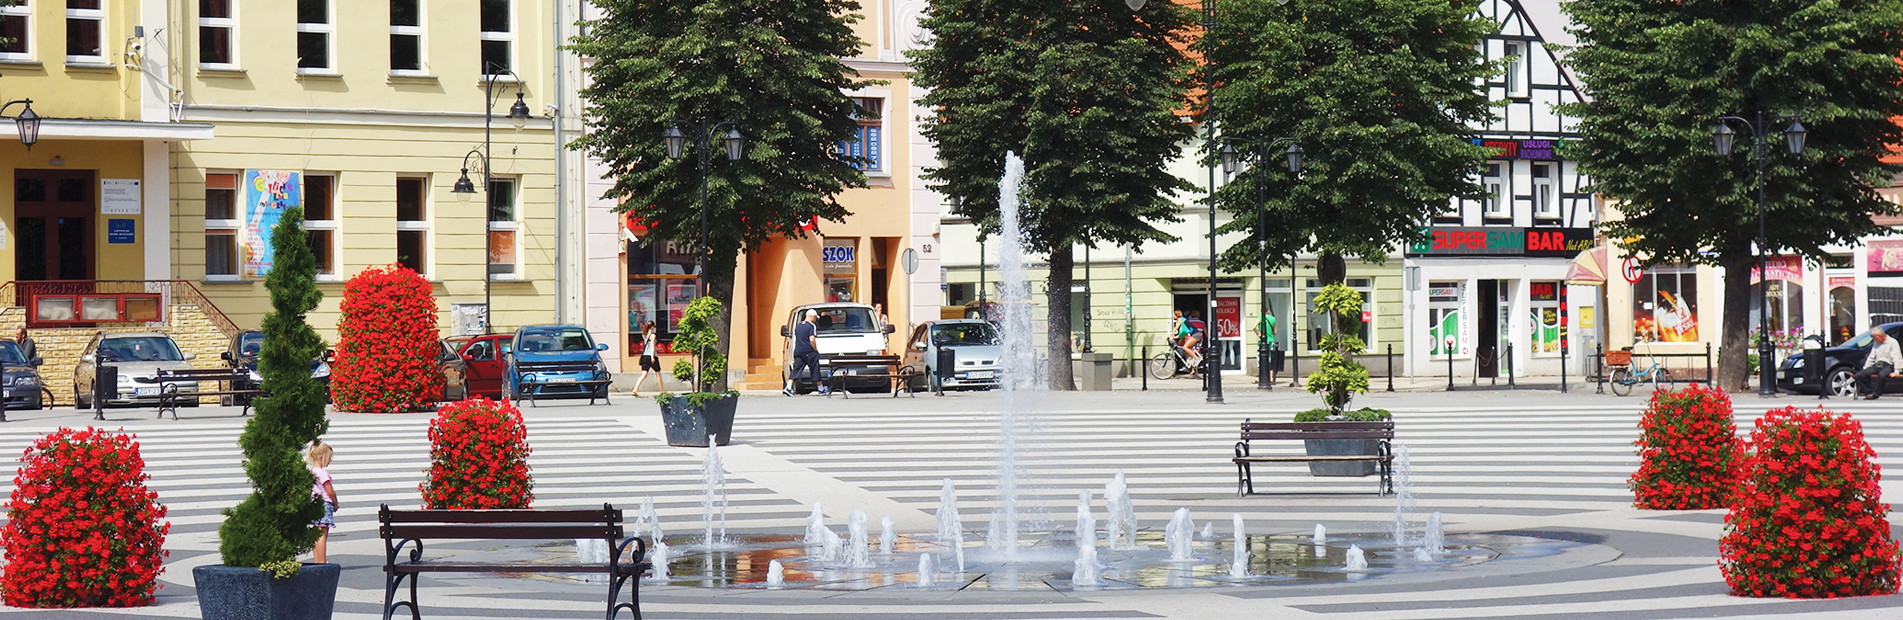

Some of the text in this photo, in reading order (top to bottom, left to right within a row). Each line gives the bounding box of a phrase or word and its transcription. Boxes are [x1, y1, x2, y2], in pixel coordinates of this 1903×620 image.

[1523, 140, 1550, 148] USŁUGI
[1527, 231, 1565, 250] BAR
[823, 246, 855, 262] SZOK
[923, 244, 932, 253] 52
